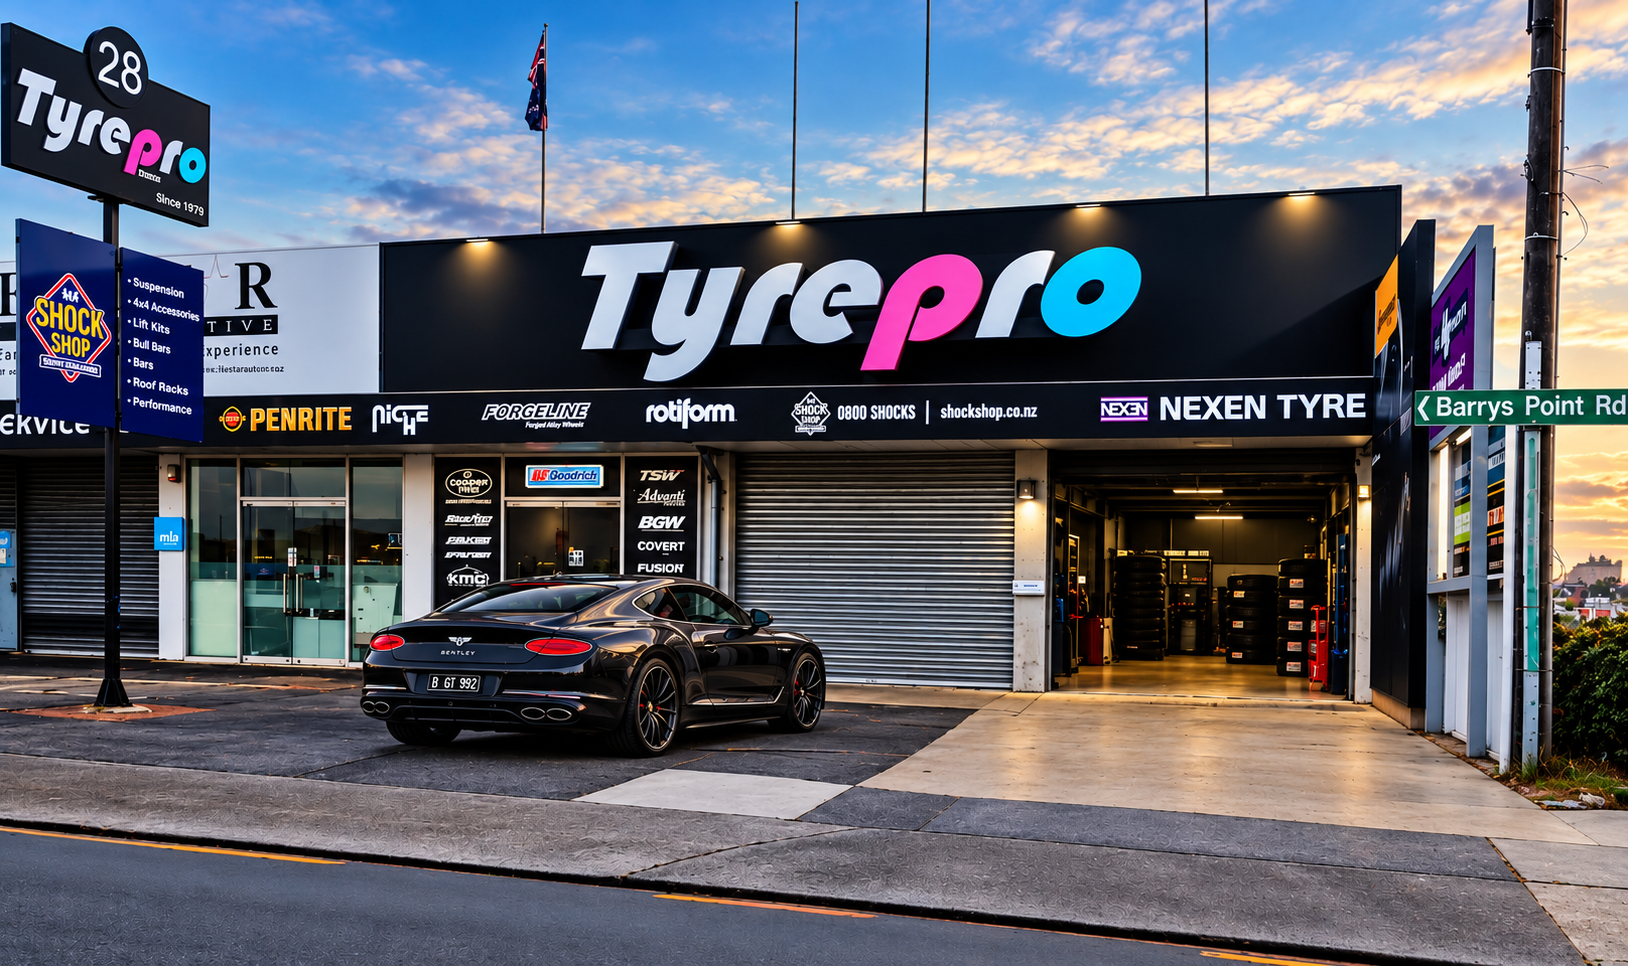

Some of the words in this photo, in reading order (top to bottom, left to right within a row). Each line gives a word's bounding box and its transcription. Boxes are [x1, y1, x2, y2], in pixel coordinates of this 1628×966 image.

[98, 41, 142, 95] 28
[17, 68, 207, 184] Tyrepro
[156, 192, 181, 209] Since
[183, 201, 205, 216] 1979
[133, 277, 185, 299] Suspension
[35, 297, 104, 340] SHOCK
[133, 298, 149, 310] 4x4
[151, 302, 200, 322] Accessories
[581, 240, 1142, 382] Tyrepro
[133, 318, 149, 330] Lift
[151, 322, 170, 335] Kits
[51, 332, 91, 358] SHOP
[133, 338, 149, 350] Bull
[151, 342, 171, 354] Bars
[203, 343, 279, 360] xperience
[133, 357, 154, 370] Bars
[133, 377, 157, 390] Roof
[159, 382, 189, 396] Racks
[133, 397, 192, 415] Performance
[481, 402, 591, 421] FORGELINE
[645, 398, 736, 430] rotiform
[795, 404, 827, 415] SHOCK
[837, 405, 867, 420] 0800
[870, 404, 916, 420] SHOCKS
[940, 403, 1038, 421] shockshop.co.nz
[1100, 402, 1148, 417] NEXEN
[1160, 394, 1266, 421] NEXEN
[1276, 393, 1367, 419] TYRE
[1436, 396, 1514, 422] Barrys
[1525, 395, 1584, 416] Point
[1595, 394, 1627, 416] Rd
[250, 406, 352, 431] PENRITE
[640, 469, 685, 481] TSW
[637, 487, 686, 503] Advanti
[637, 515, 686, 529] BGW
[637, 540, 686, 551] COVERT
[637, 563, 685, 573] FUSION
[431, 676, 439, 688] B
[459, 677, 477, 690] 992
